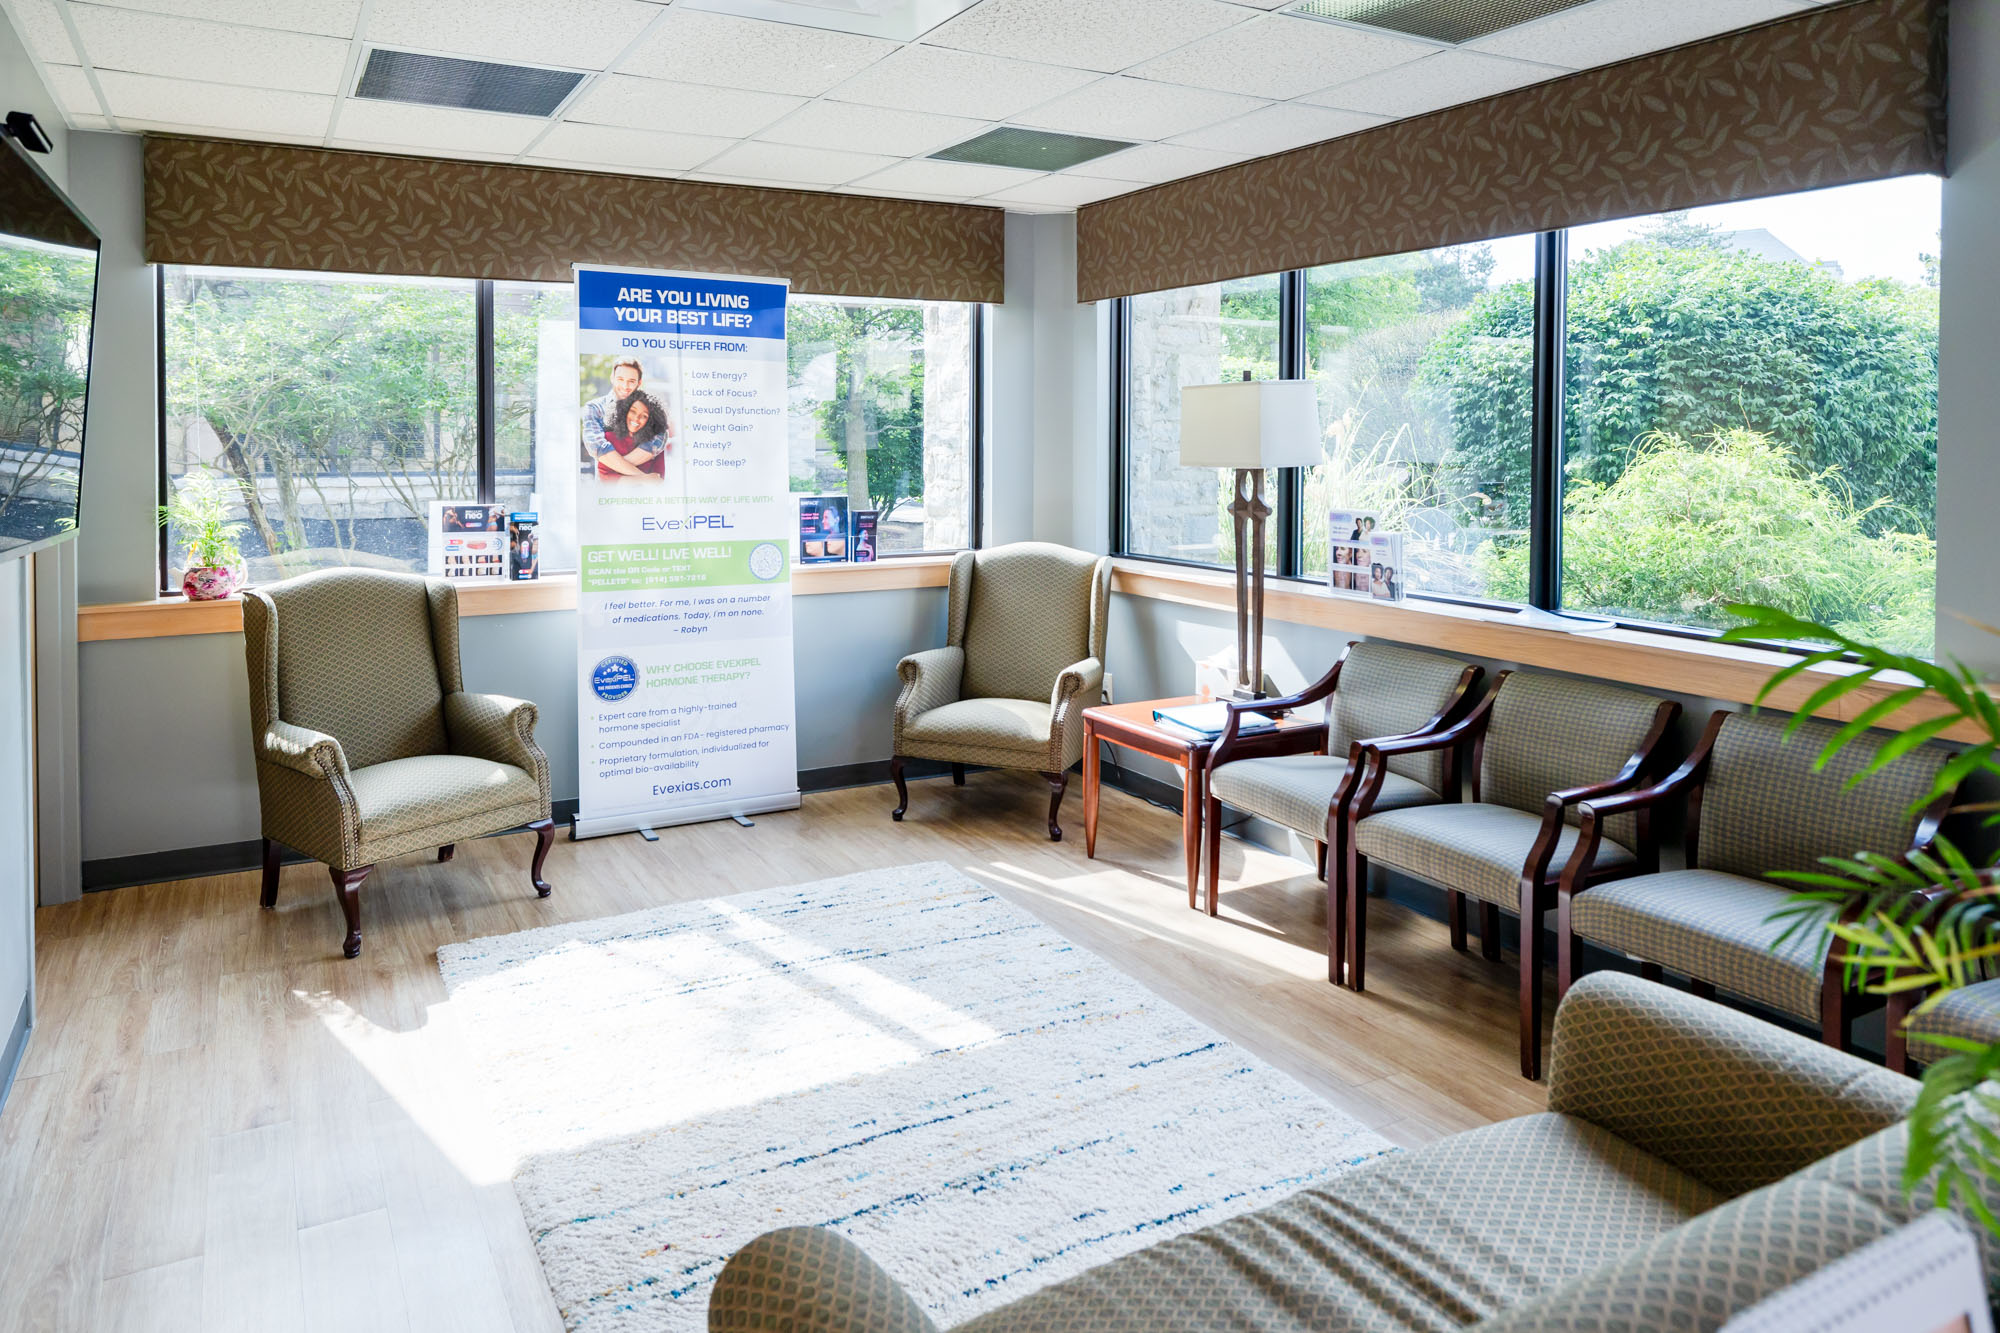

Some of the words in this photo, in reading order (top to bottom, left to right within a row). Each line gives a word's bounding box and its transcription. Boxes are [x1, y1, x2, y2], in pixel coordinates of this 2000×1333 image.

[618, 287, 652, 303] ARE
[657, 290, 691, 306] YOU
[696, 292, 749, 308] LIVING
[614, 307, 662, 323] YOUR
[666, 310, 708, 325] BEST
[713, 313, 752, 328] LIFE?
[622, 338, 639, 347] DO
[642, 339, 665, 348] YOU
[669, 341, 710, 351] SUFFER
[714, 342, 748, 352] FROM:
[692, 371, 709, 379] Low
[712, 372, 748, 382] Energy?
[692, 389, 712, 397] Lack
[726, 390, 757, 398] Focus?
[726, 407, 780, 417] Dysfunction?
[693, 424, 725, 433] Weight
[728, 424, 753, 432] Gain?
[693, 441, 731, 450] Anxiety?
[693, 459, 713, 467] Poor
[716, 459, 746, 469] Sleep?
[665, 497, 696, 505] BETTER
[721, 496, 732, 504] OF
[465, 512, 483, 520] neo
[588, 551, 614, 563] GET
[618, 549, 659, 562] WELL!
[663, 547, 689, 560] LIVE
[692, 546, 731, 559] WELL!
[588, 568, 610, 576] SCAN
[609, 601, 625, 610] feel
[628, 600, 657, 609] better.
[660, 599, 673, 607] For
[676, 599, 690, 608] me,
[738, 595, 771, 603] number
[612, 615, 622, 624] of
[624, 613, 680, 623] medications.
[684, 611, 711, 621] Today,
[714, 610, 726, 618] I'm
[741, 608, 764, 616] none.
[681, 625, 707, 635] Robyn
[601, 658, 628, 667] CERTIFIED
[646, 665, 671, 674] WHY
[674, 661, 714, 672] CHOOSE
[717, 658, 761, 668] EVEXIPEL
[646, 677, 698, 688] HORMONE
[701, 672, 750, 683] THERAPY?
[601, 691, 628, 700] PROVIDER
[599, 712, 625, 722] Expert
[627, 710, 647, 719] care
[649, 707, 668, 717] from
[679, 702, 737, 715] highly-trained
[599, 724, 638, 733] hormone
[641, 719, 680, 731] specialist
[599, 736, 659, 750] Compounded
[671, 734, 681, 742] an
[706, 728, 747, 740] registered
[749, 724, 789, 738] pharmacy
[600, 754, 647, 767] Proprietary
[649, 748, 699, 761] formulation,
[701, 743, 756, 754] individualized
[758, 740, 769, 748] for
[600, 767, 633, 778] optimal
[636, 760, 699, 774] bio-availability
[653, 777, 731, 796] Evexias.com
